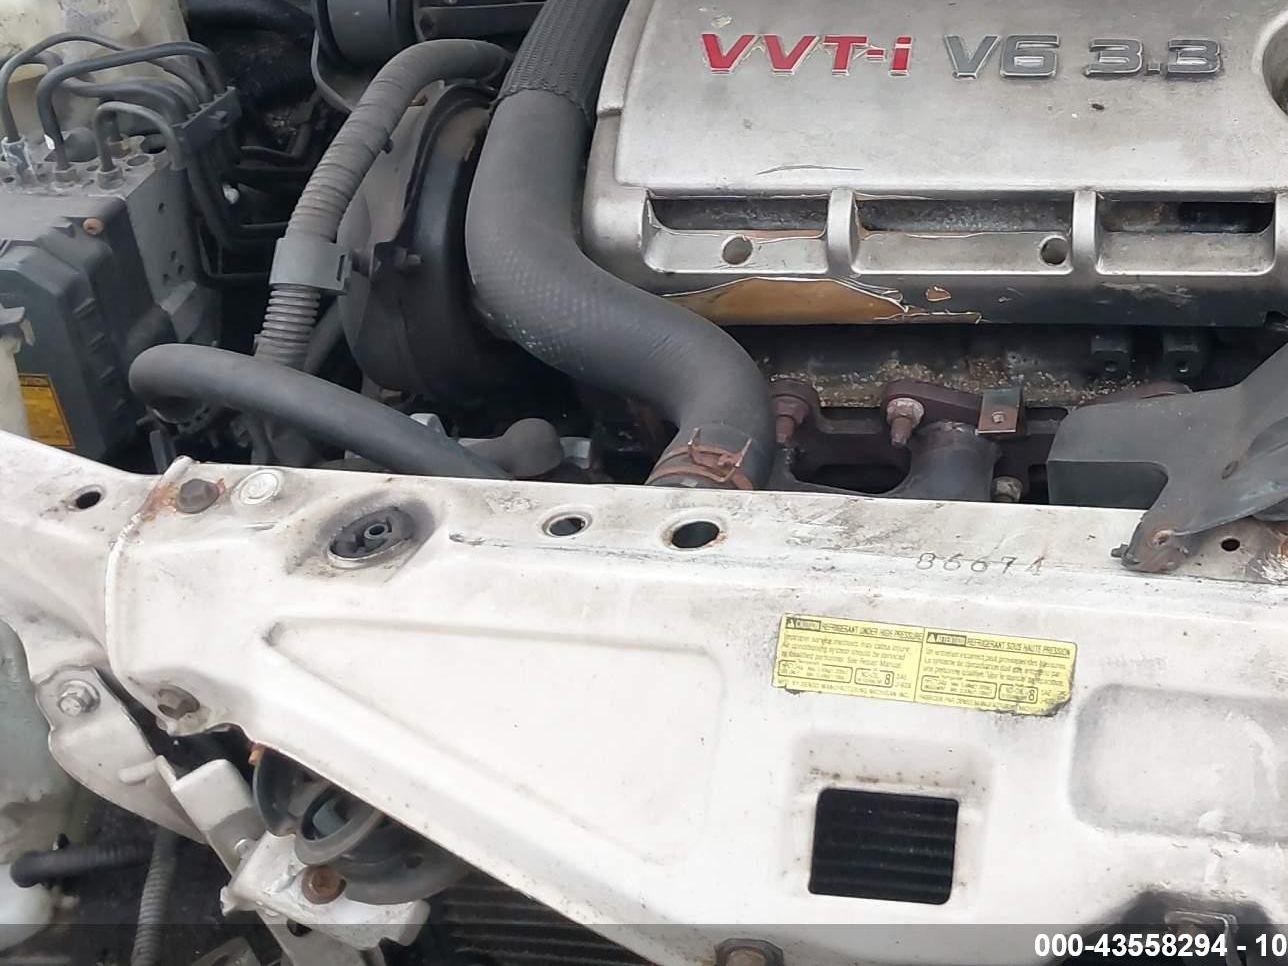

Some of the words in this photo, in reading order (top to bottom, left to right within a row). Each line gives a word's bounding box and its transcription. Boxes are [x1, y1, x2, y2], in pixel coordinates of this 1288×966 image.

[701, 33, 912, 77] VVT-i
[943, 33, 1060, 79] V6
[1084, 37, 1221, 78] 3.3
